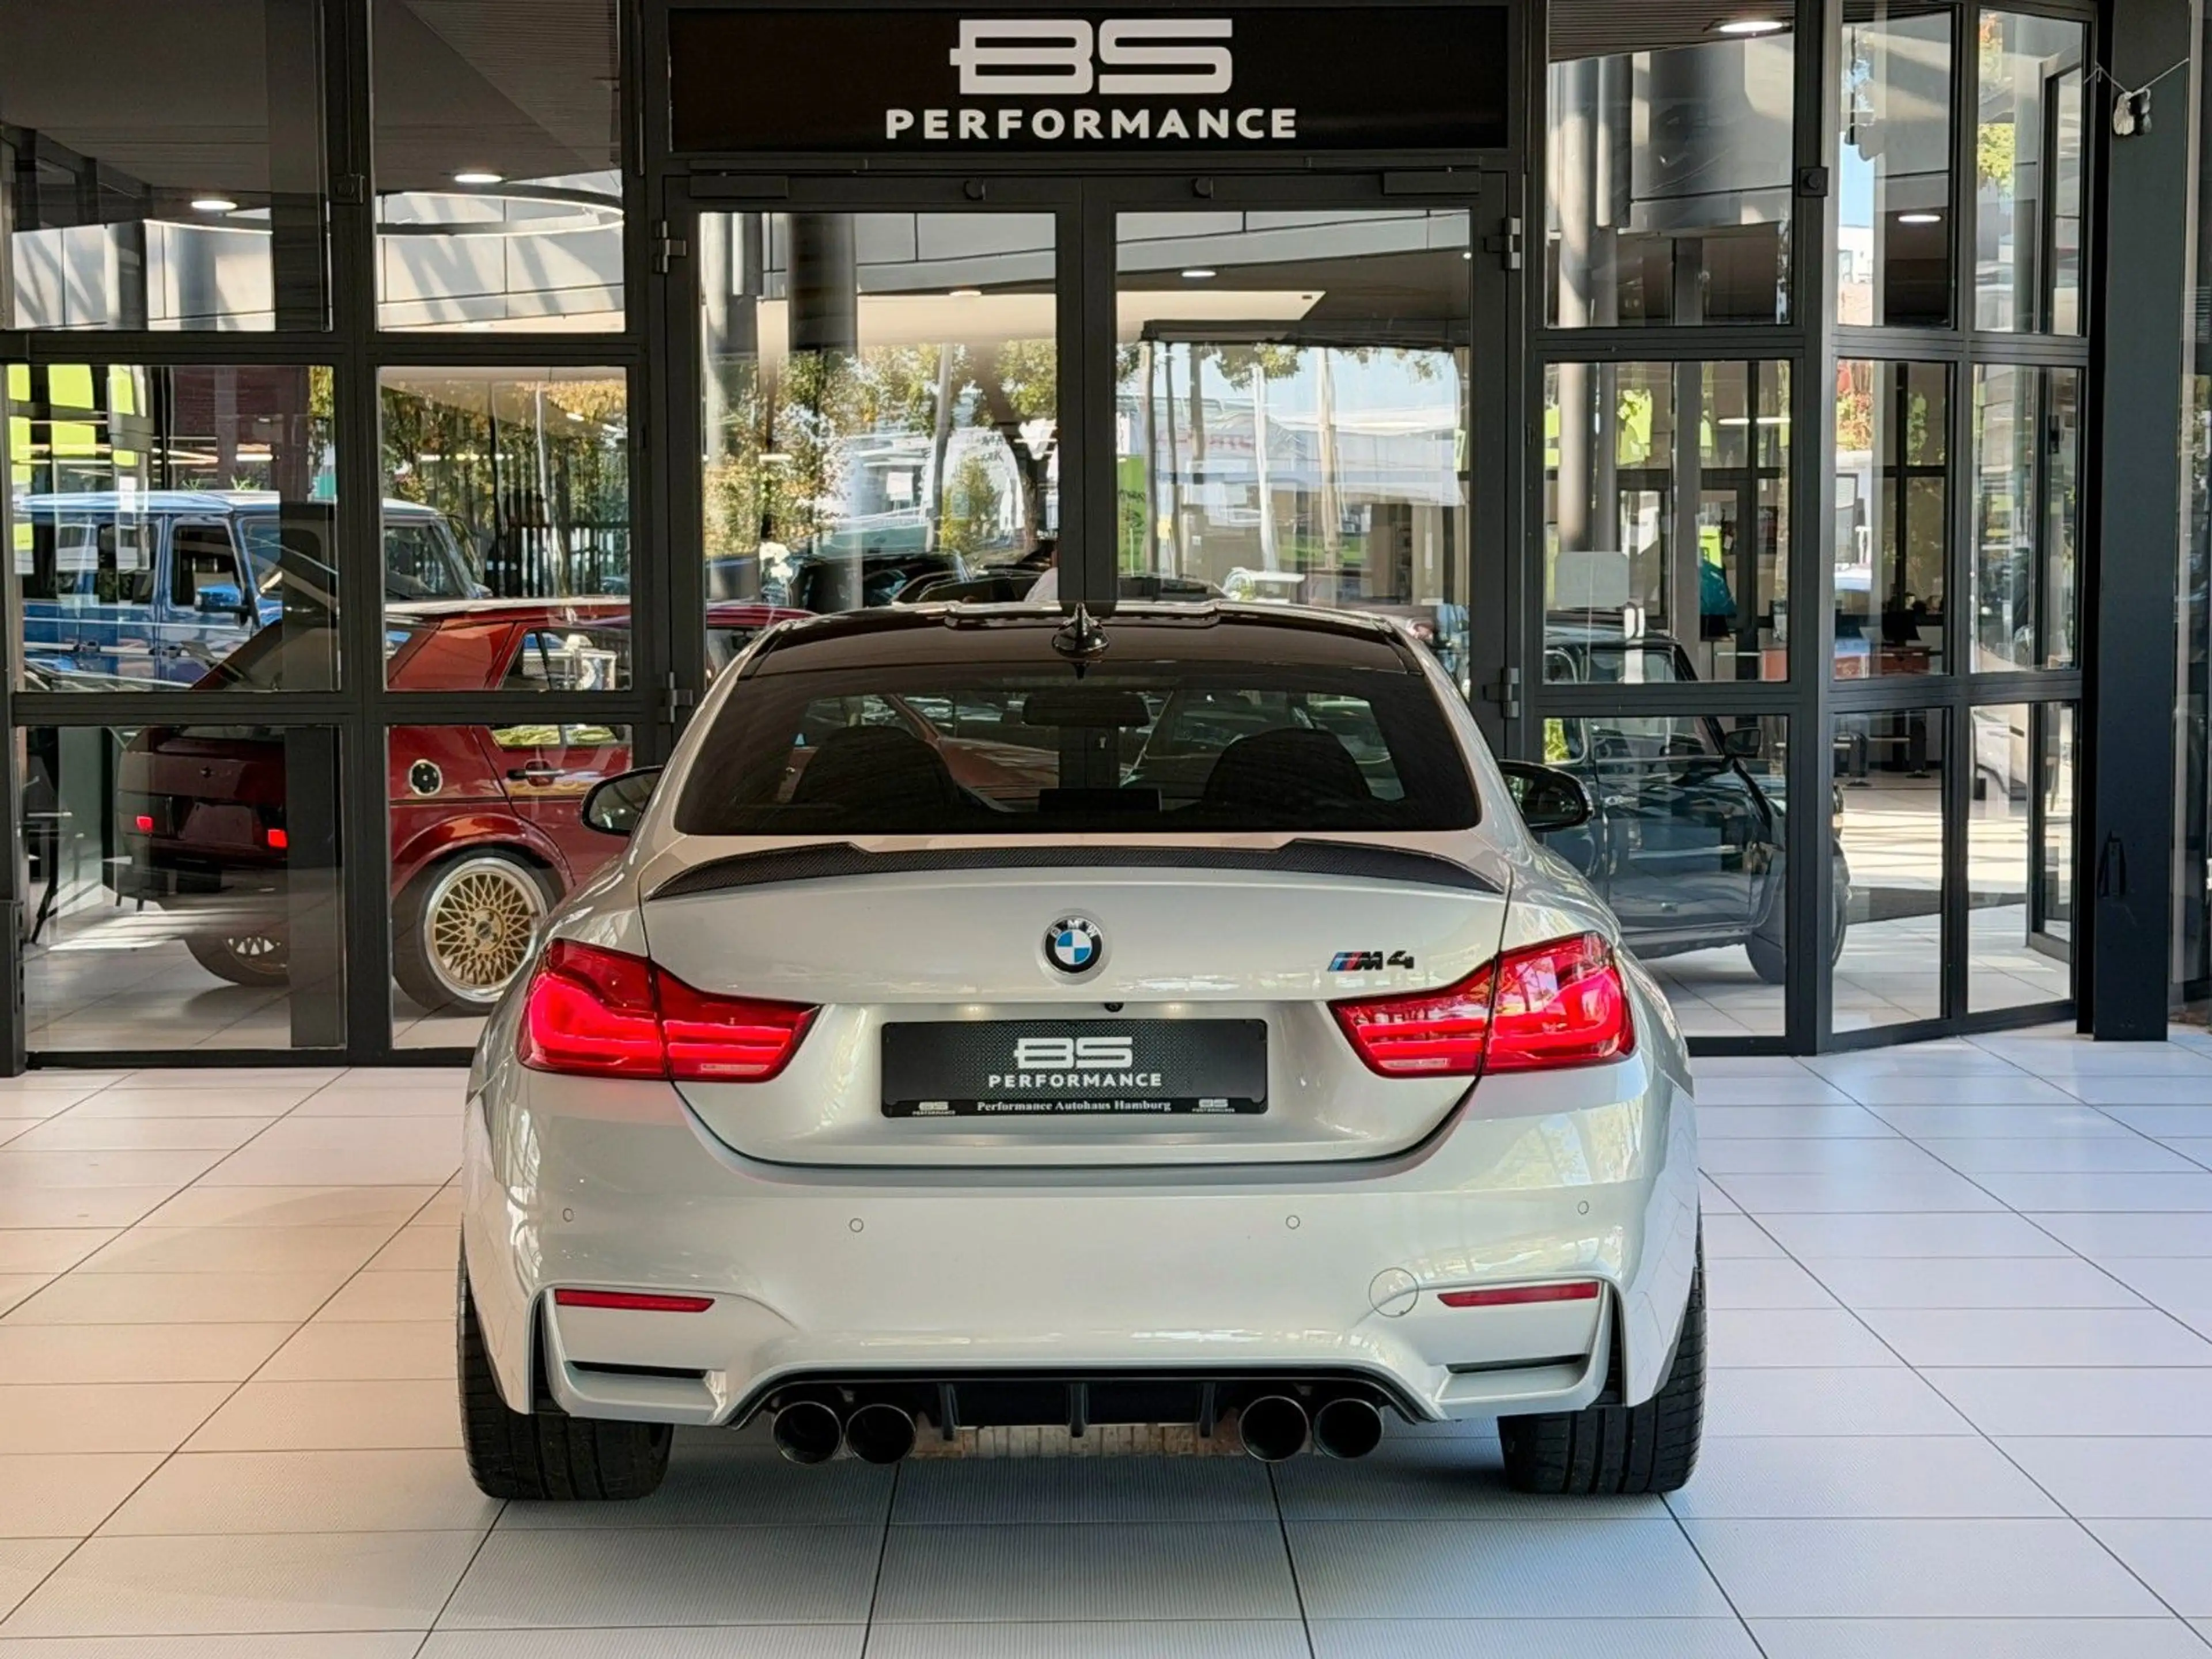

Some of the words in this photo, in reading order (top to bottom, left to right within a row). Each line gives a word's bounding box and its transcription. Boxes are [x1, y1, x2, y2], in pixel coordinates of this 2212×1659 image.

[950, 18, 1232, 94] BS
[886, 108, 1296, 139] PERFORMANCE
[1050, 919, 1099, 938] BMW
[1014, 1037, 1132, 1069] BS
[988, 1073, 1161, 1088] PERFORMANCE
[977, 1101, 1052, 1111] Performance
[1055, 1100, 1111, 1111] Autohaus
[1114, 1100, 1172, 1112] Hamburg
